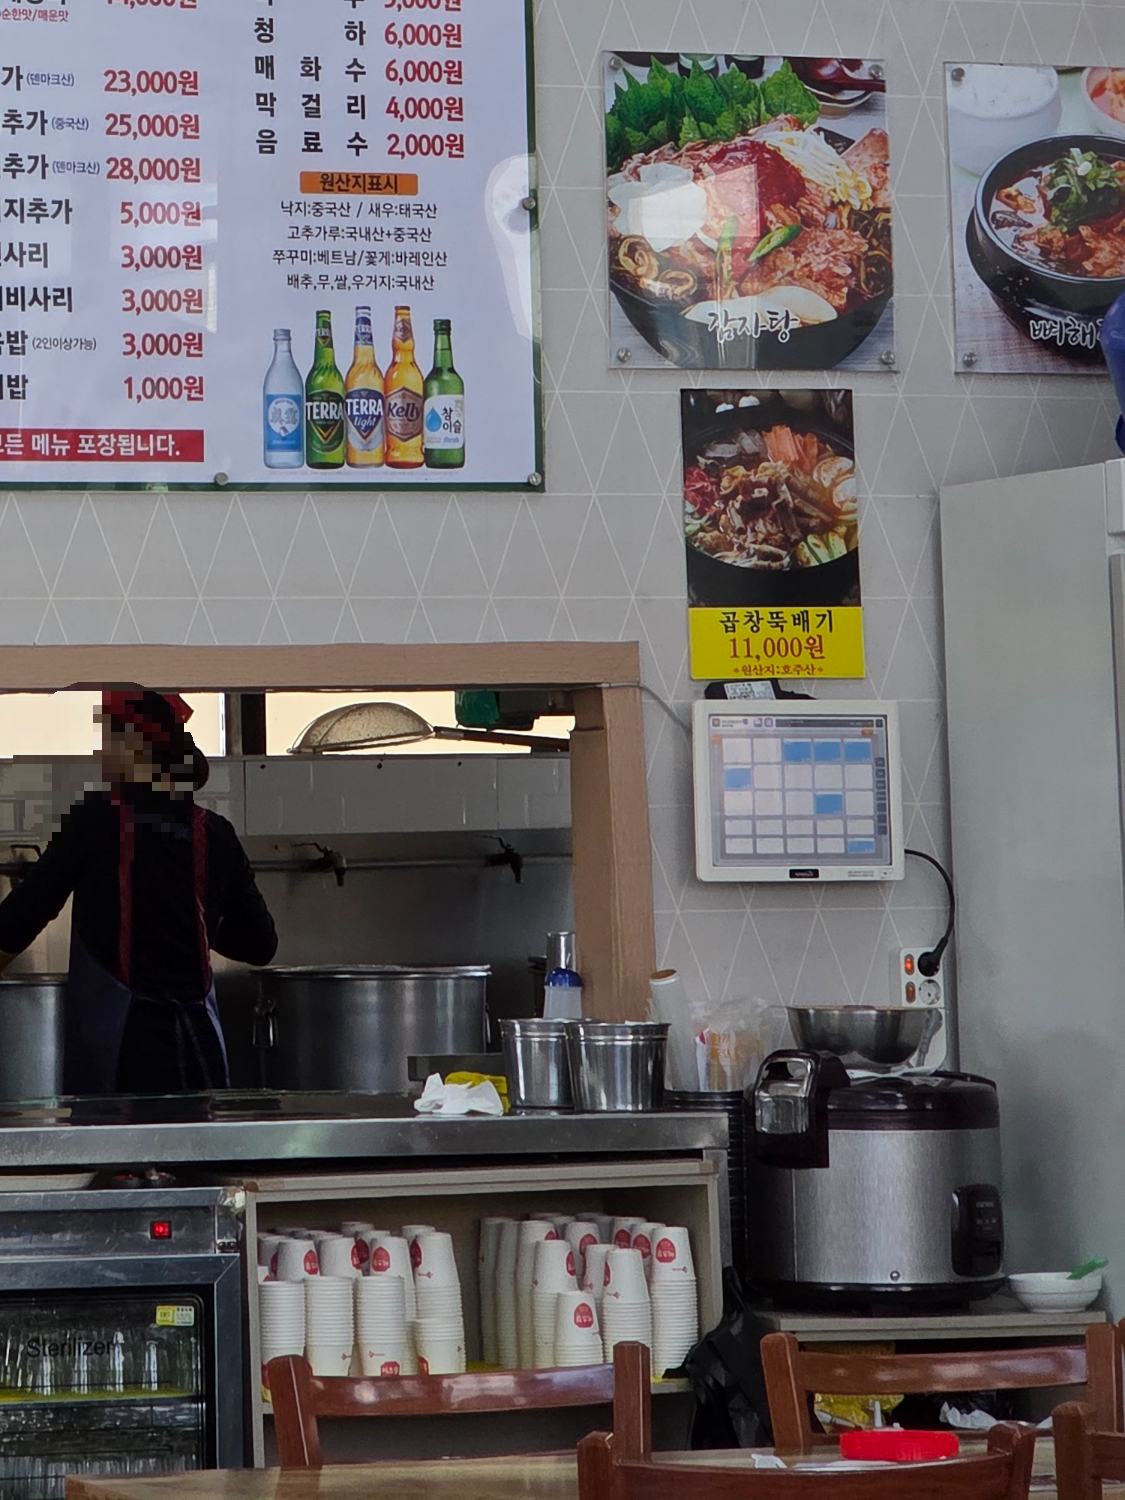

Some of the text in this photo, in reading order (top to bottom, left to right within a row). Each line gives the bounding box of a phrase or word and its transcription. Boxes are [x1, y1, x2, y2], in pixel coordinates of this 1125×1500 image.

[253, 17, 462, 49] 청 하 6,000원
[26, 72, 75, 87] (덴마크산)
[103, 69, 199, 97] 23,000원
[254, 54, 463, 86] 매 화 수 6,000원
[255, 92, 464, 123] 막 걸 리 4,000원
[51, 117, 89, 131] (중국산)
[105, 113, 201, 140] 25,000원
[256, 129, 465, 159] 음 료 수 2,000원
[52, 160, 100, 175] (덴마크산)
[105, 157, 201, 184] 28,000원
[319, 172, 399, 193] 원산지표시
[120, 201, 202, 228] 5,000원
[280, 200, 352, 218] 낙지:중국산
[368, 201, 438, 219] 새우:태국산
[121, 244, 203, 272] 3,000원
[121, 288, 203, 316] 3,000원
[708, 308, 799, 343] 감자탕
[1029, 316, 1103, 349] 뼈해
[32, 337, 97, 351] (2인이상가능)
[122, 332, 204, 359] 3,000원
[124, 376, 204, 403] 1,000원
[306, 401, 344, 421] TERRA
[346, 399, 383, 416] TERRA
[387, 402, 422, 422] Kelly
[442, 406, 453, 421] 참
[31, 433, 71, 456] 메뉴
[77, 433, 181, 457] 포장됩니다.
[719, 610, 833, 633] 곱창뚝배기
[730, 634, 825, 662] 11,000원
[27, 1336, 113, 1358] Sterilizer
